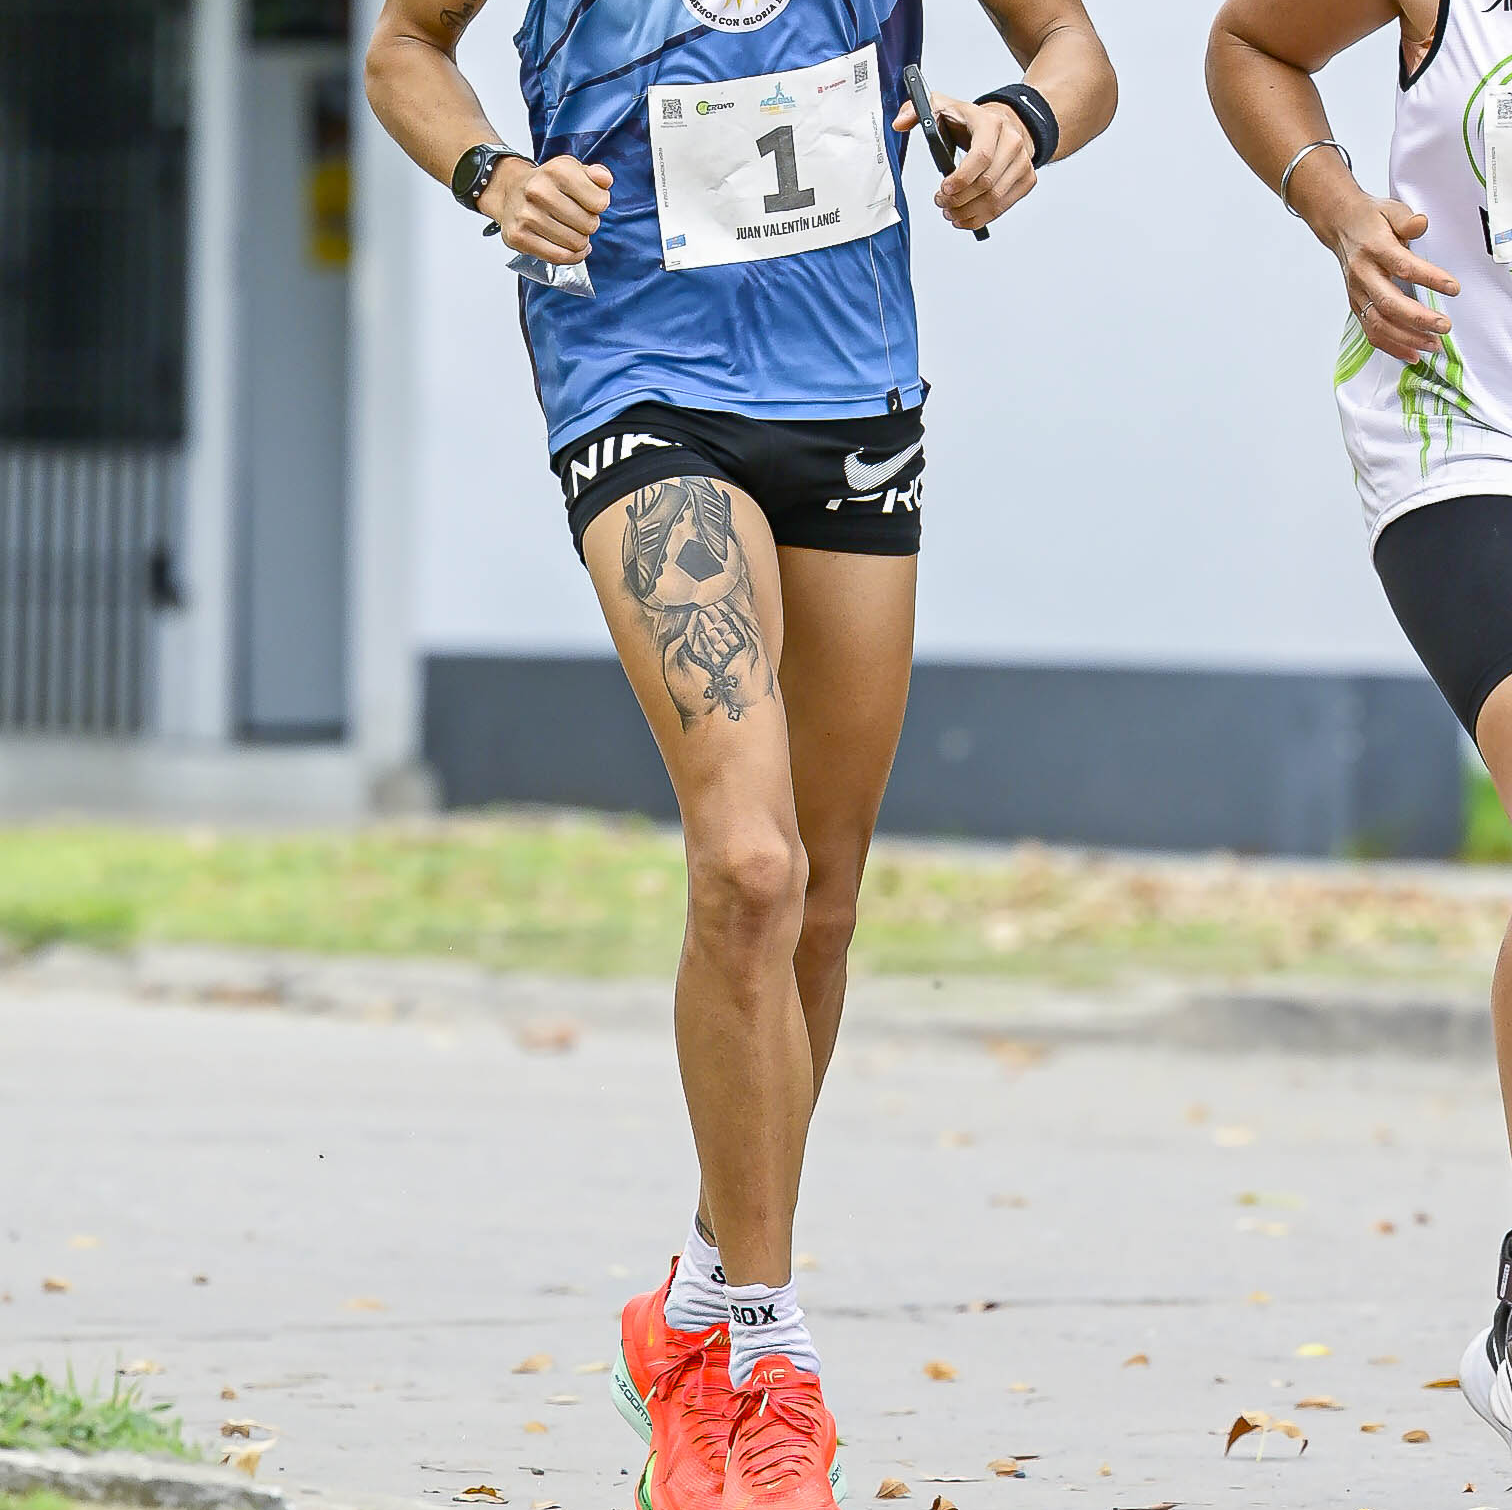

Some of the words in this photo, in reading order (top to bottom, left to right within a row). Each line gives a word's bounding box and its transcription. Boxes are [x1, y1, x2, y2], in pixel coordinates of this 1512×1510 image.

[718, 17, 740, 27] CON
[742, 3, 777, 26] GLORIA
[756, 125, 816, 213] 1
[736, 225, 761, 240] JUAN
[763, 216, 810, 238] VALENTÍN
[812, 207, 841, 228] LANGÉ
[731, 1304, 778, 1325] SOX
